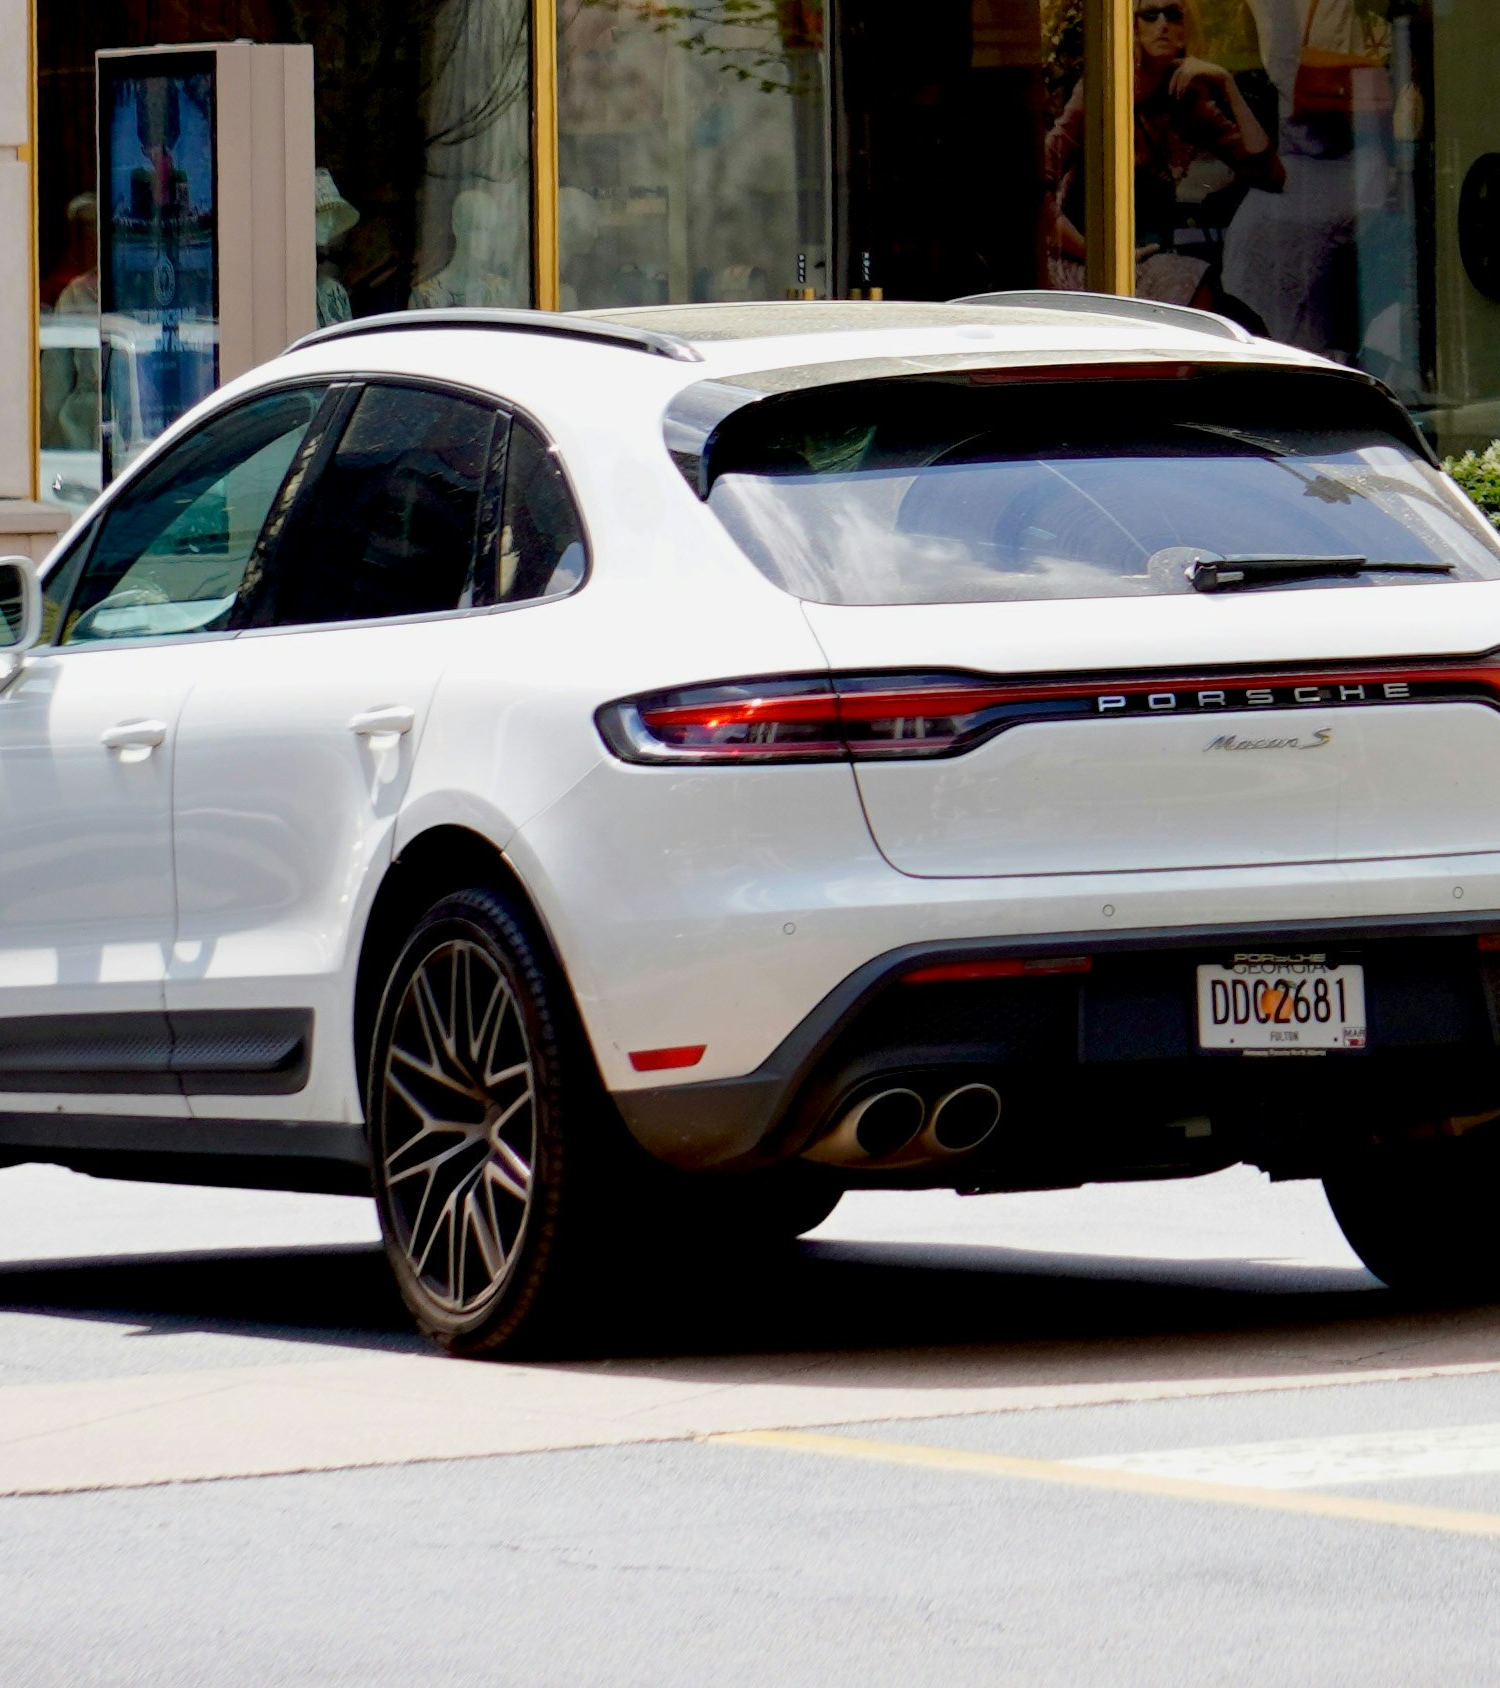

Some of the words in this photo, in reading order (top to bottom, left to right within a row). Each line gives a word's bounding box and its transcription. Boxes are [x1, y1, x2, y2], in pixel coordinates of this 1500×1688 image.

[1097, 682, 1410, 713] PORSCHE
[1202, 733, 1301, 753] Macan
[1299, 726, 1333, 750] S
[1232, 963, 1328, 975] GEORGIA
[1234, 953, 1327, 963] PORSCHE
[1211, 977, 1346, 1025] DDC2681
